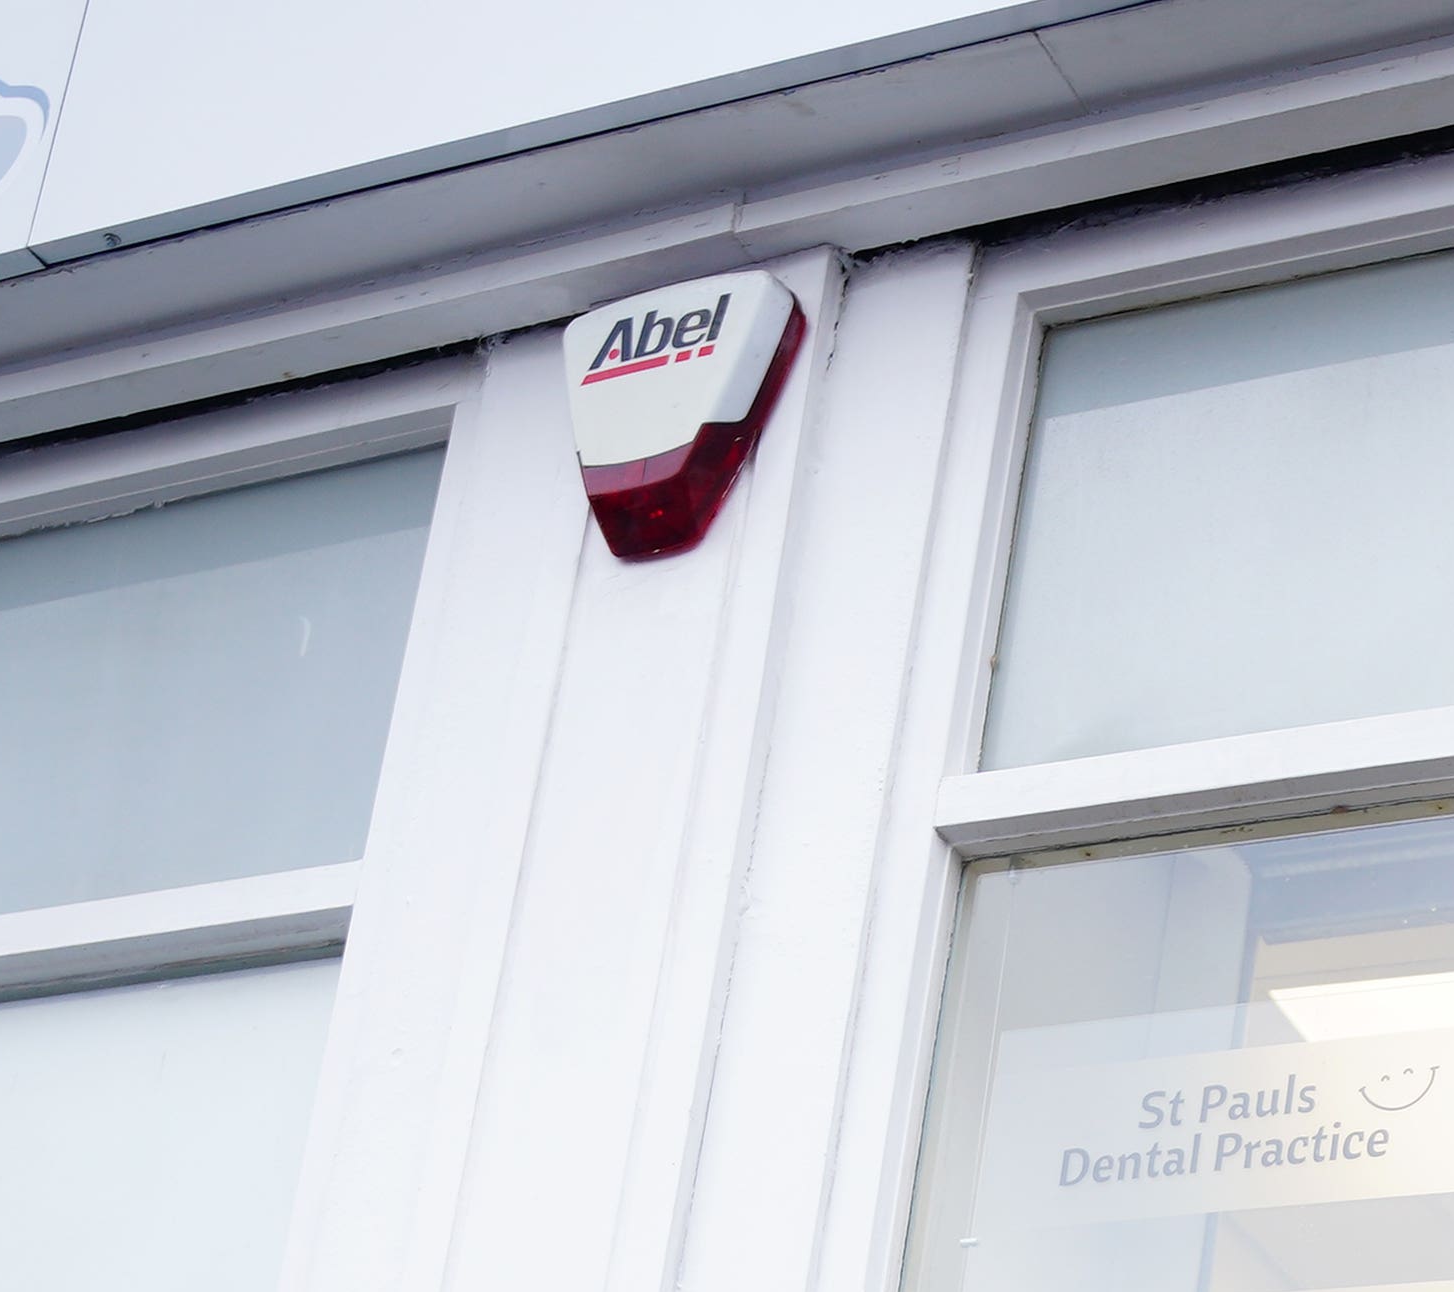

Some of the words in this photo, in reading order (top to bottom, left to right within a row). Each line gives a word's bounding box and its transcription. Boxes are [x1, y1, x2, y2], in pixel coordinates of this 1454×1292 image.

[589, 293, 732, 371] Abel
[1138, 1088, 1185, 1130] St
[1199, 1073, 1317, 1124] Pauls
[1058, 1133, 1203, 1187] Dental
[1213, 1121, 1390, 1172] Practice
